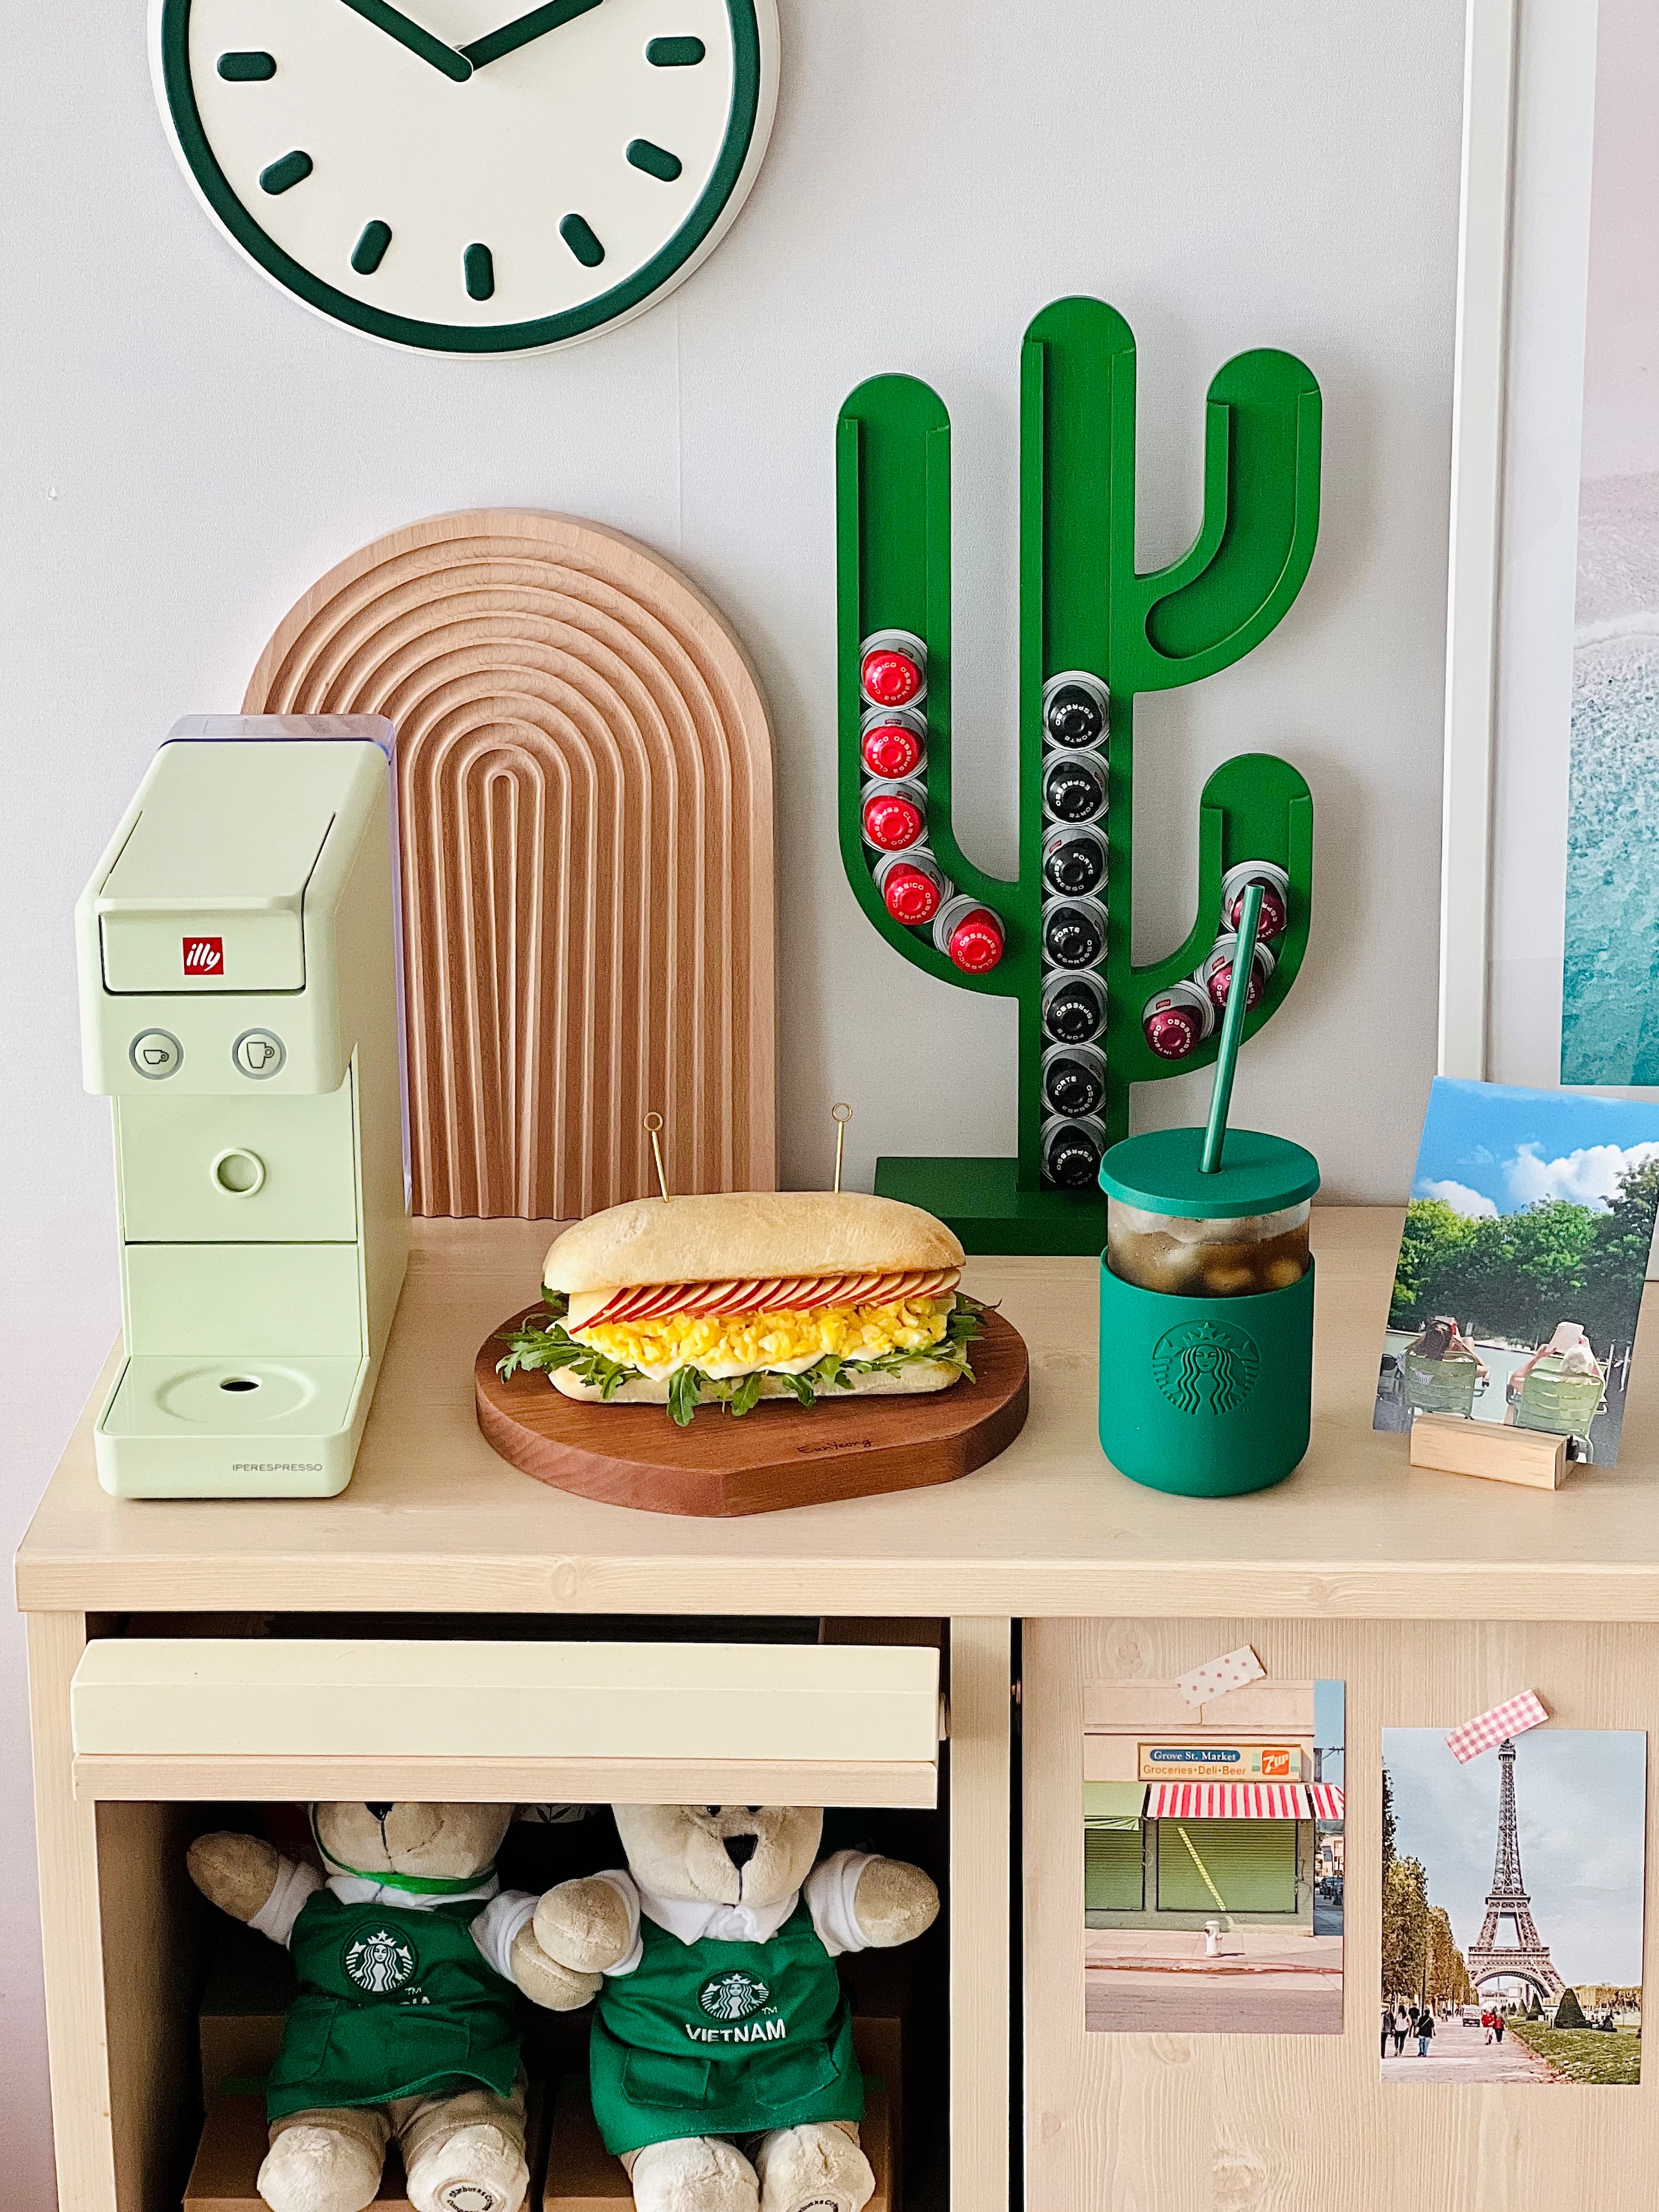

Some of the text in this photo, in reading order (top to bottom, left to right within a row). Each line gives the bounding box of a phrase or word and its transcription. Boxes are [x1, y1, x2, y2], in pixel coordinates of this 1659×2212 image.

[871, 662, 897, 695] CLASSICO
[884, 666, 912, 701] ESPRESSO
[1055, 703, 1094, 726] ESPRESSO
[1064, 730, 1093, 743] FORTE
[872, 736, 889, 773] CLASSICO
[893, 736, 912, 774] ESPRESSO
[1055, 780, 1091, 806] ESPRESSO
[1069, 802, 1094, 818] FORTE
[890, 811, 914, 845] CLASSICO
[1073, 852, 1094, 875] FORTE
[1054, 859, 1084, 892] ESPRESSO
[892, 882, 924, 908] CLASSICO
[898, 892, 932, 920] ESPRESSO
[959, 933, 997, 955] ESPRESSO
[1054, 926, 1080, 942] FORTE
[186, 942, 221, 972] illy
[957, 950, 993, 970] CLASSICO
[1056, 1002, 1093, 1025] ESPRESSO
[1153, 1024, 1172, 1055] INTENSO
[1167, 1018, 1191, 1053] ESPRESSO
[1054, 1076, 1076, 1095] FORTE
[1056, 1148, 1093, 1170] ESPRESSO
[232, 1463, 323, 1471] IPERESPRESSO
[1154, 1751, 1236, 1761] Grove St. Market
[1143, 1765, 1246, 1775] Groceries Deli Beer
[761, 2006, 778, 2015] TM
[685, 2018, 786, 2042] VIETNAM
